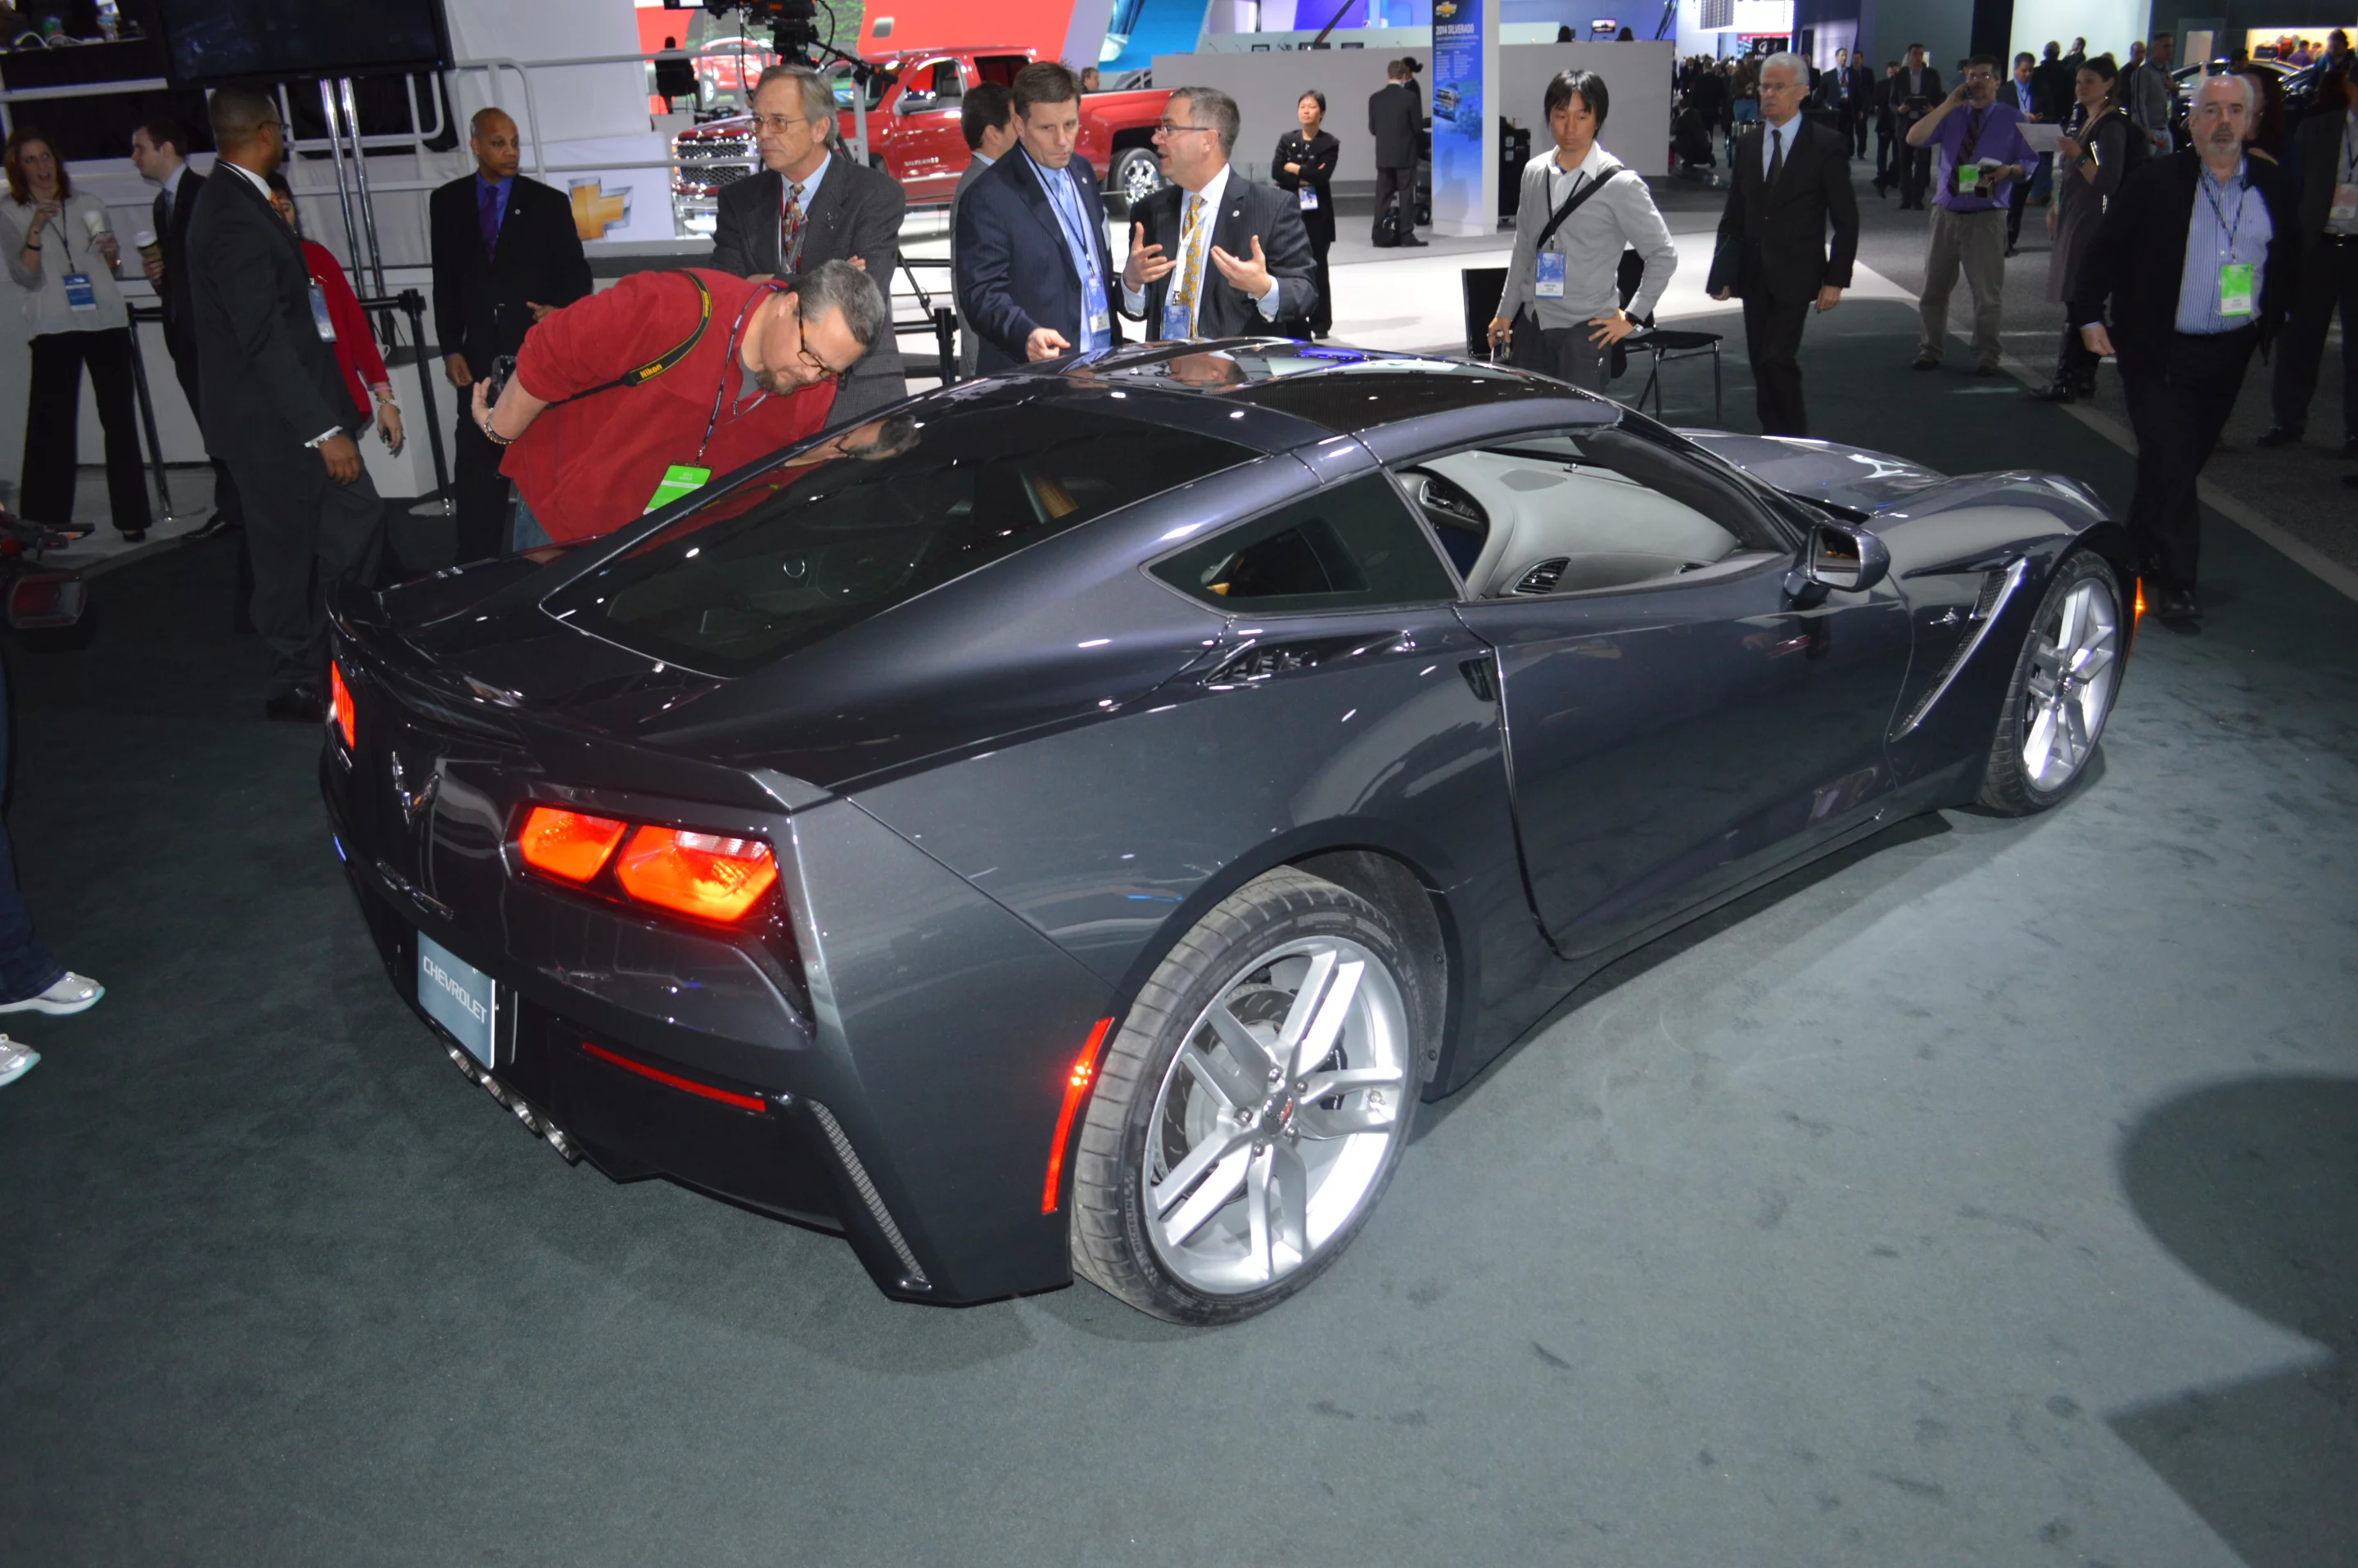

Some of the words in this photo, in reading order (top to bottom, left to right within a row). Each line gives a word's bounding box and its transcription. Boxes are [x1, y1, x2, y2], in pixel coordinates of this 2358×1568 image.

[1435, 25, 1448, 35] 2014
[1448, 23, 1475, 34] SILVERADO
[639, 364, 663, 379] Nikon
[423, 955, 488, 1024] CHEVROLET
[1126, 1200, 1141, 1253] MICHELIN
